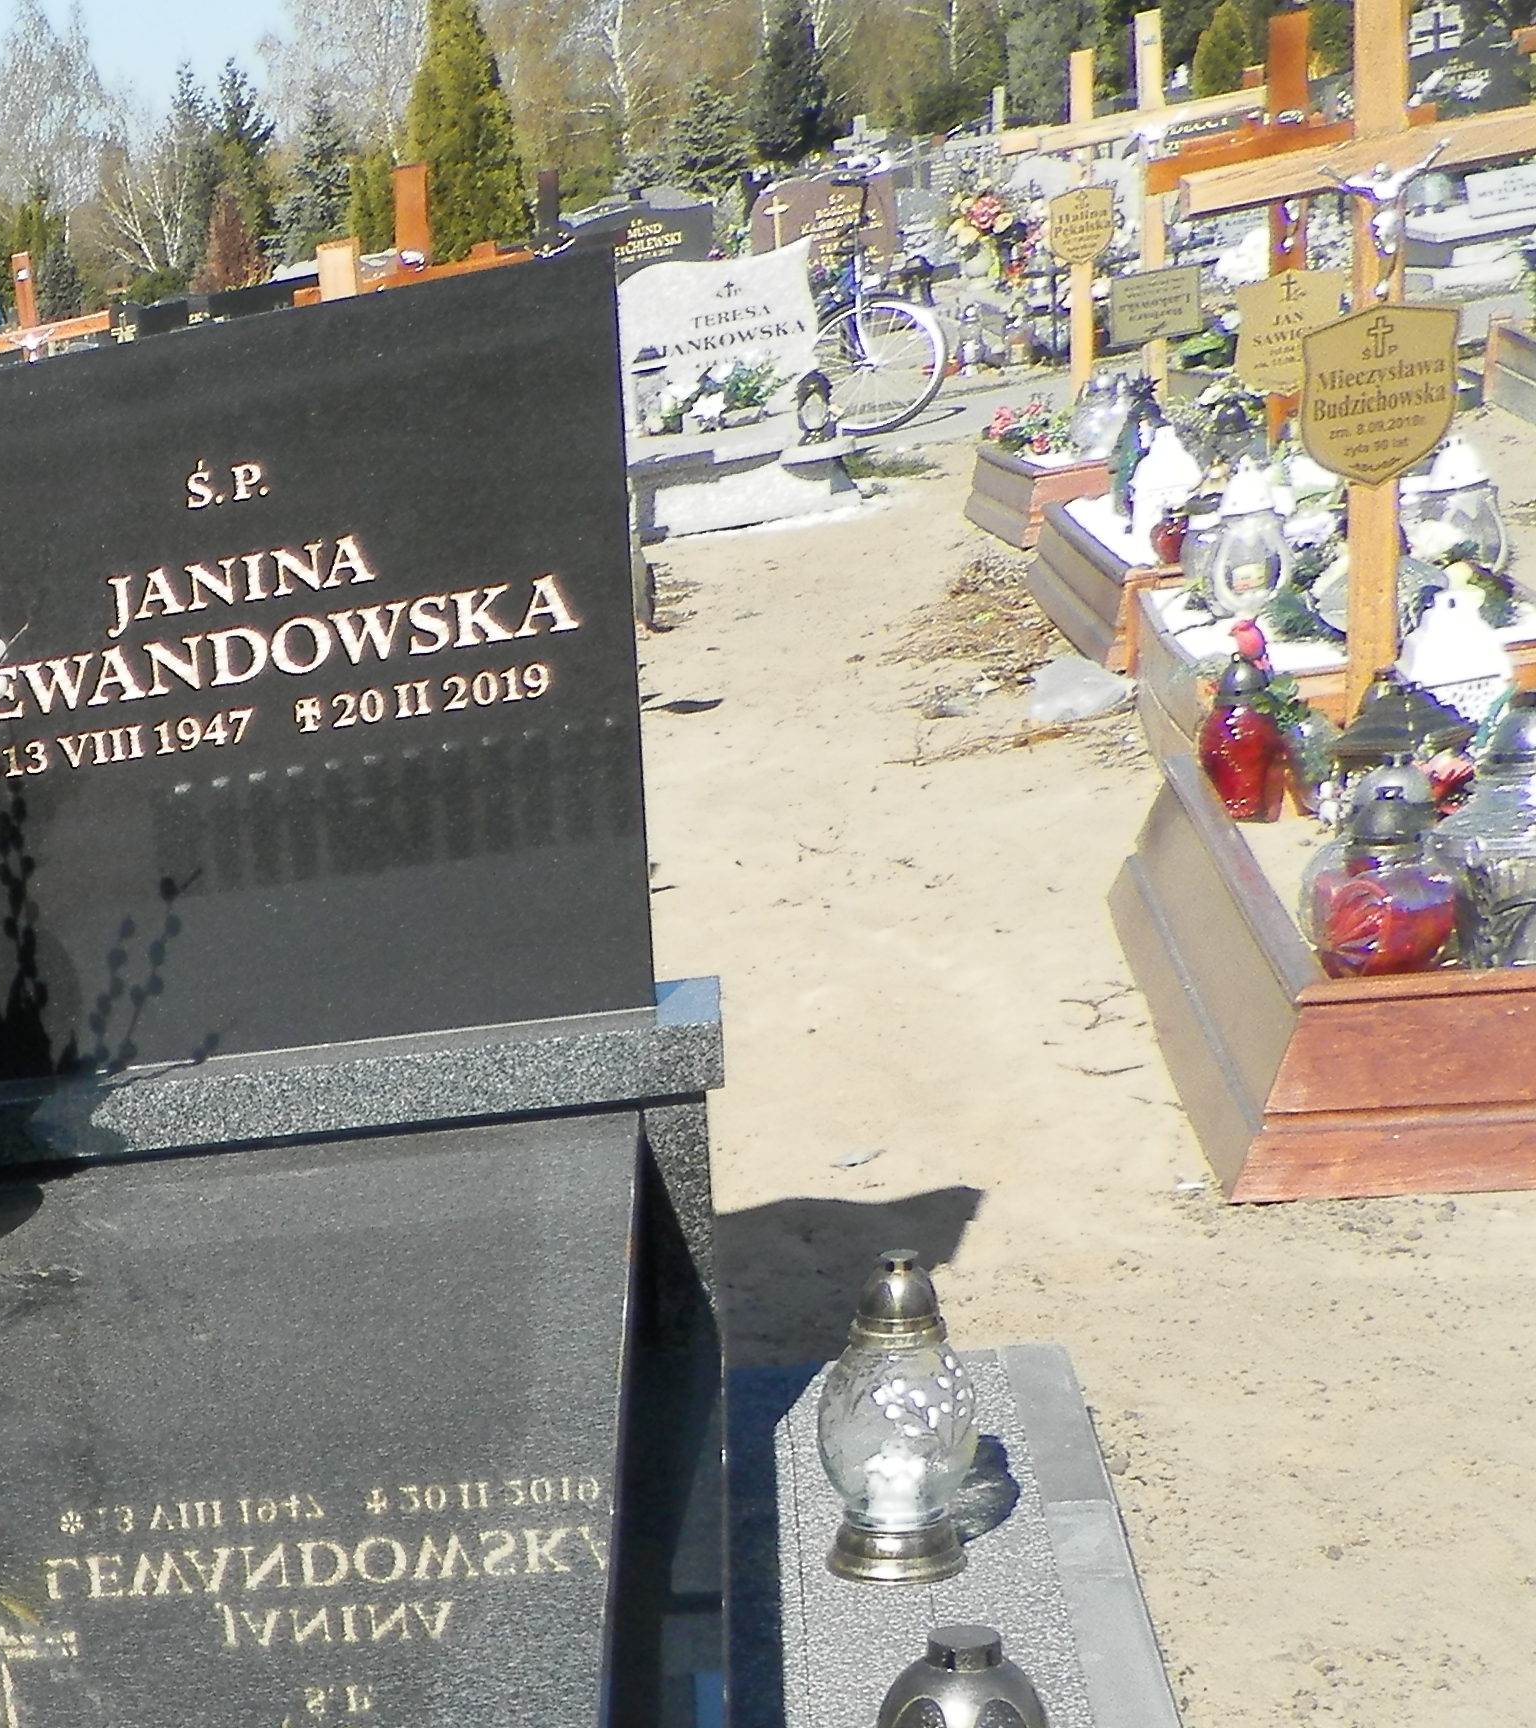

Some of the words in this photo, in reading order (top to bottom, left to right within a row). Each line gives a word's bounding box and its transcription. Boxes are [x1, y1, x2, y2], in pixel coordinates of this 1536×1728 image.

[692, 304, 771, 329] TERESA
[658, 320, 806, 357] JANKOWSKA
[1253, 326, 1306, 348] SAWIC
[1317, 358, 1446, 392] Mieczysława
[1313, 382, 1447, 422] Budzichowska
[107, 533, 377, 638] JANINA
[2, 741, 50, 778] 13
[57, 724, 145, 768] VIII
[154, 706, 255, 756] 1947
[332, 688, 386, 728] 20
[393, 679, 433, 720] II
[442, 661, 553, 712] 2019
